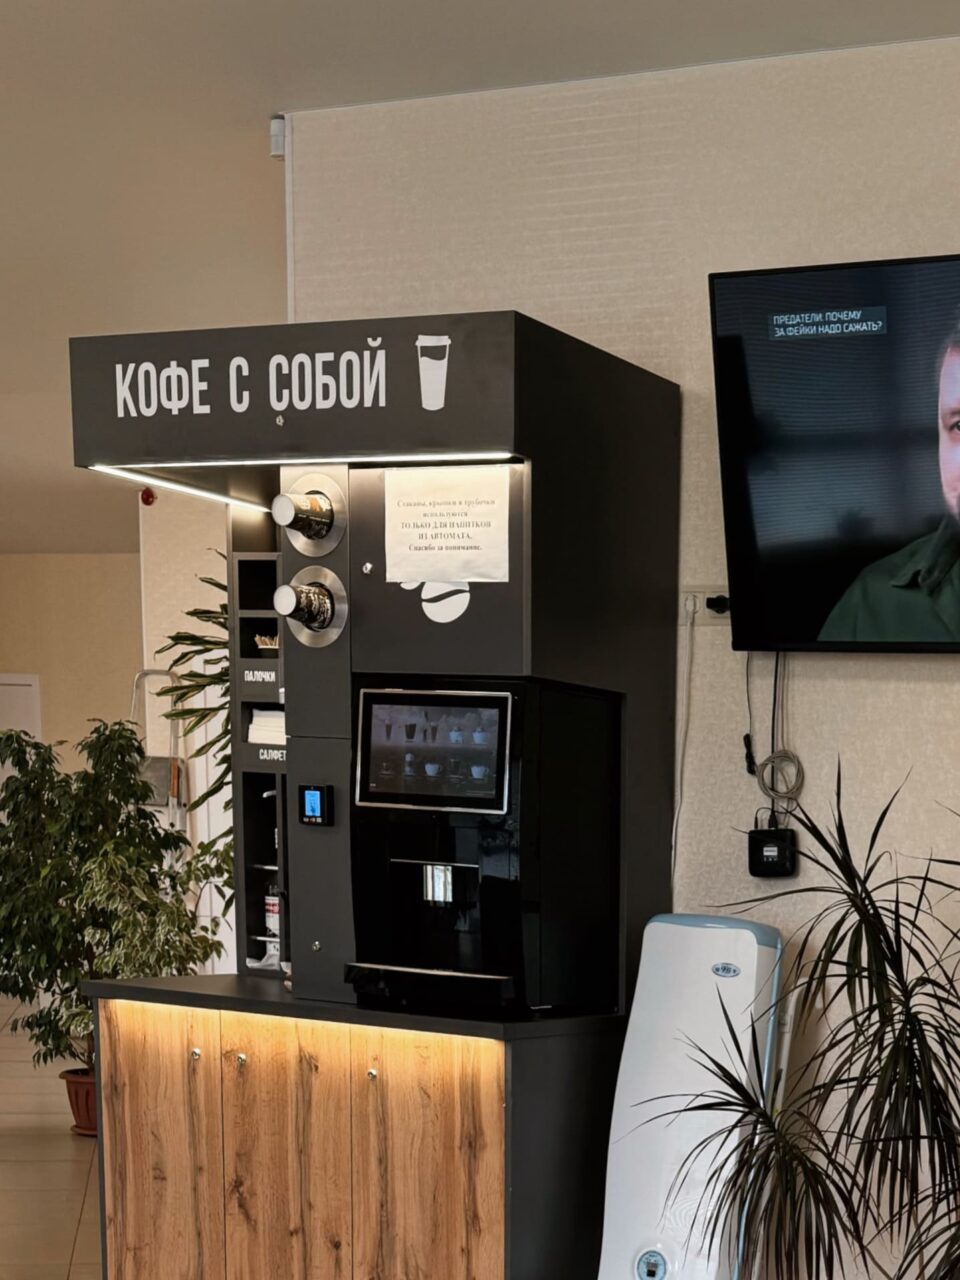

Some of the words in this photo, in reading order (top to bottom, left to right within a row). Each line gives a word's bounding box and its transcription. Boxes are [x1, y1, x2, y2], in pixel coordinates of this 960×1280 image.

[825, 310, 862, 322] ПОЧЕМУ
[774, 327, 785, 337] ЗА
[786, 324, 817, 336] ФЕЙКИ
[818, 323, 842, 334] НАДО
[843, 321, 883, 333] САЖАТЬ?
[115, 358, 211, 418] КОФЕ
[229, 356, 250, 413] С
[268, 336, 387, 412] СОБОЙ
[401, 521, 431, 529] ТОЛЬКО
[432, 521, 448, 530] ДЛЯ
[449, 520, 492, 529] НАПИТКОВ
[408, 543, 435, 551] Спасибо
[244, 670, 276, 682] ПАЛОЧКИ
